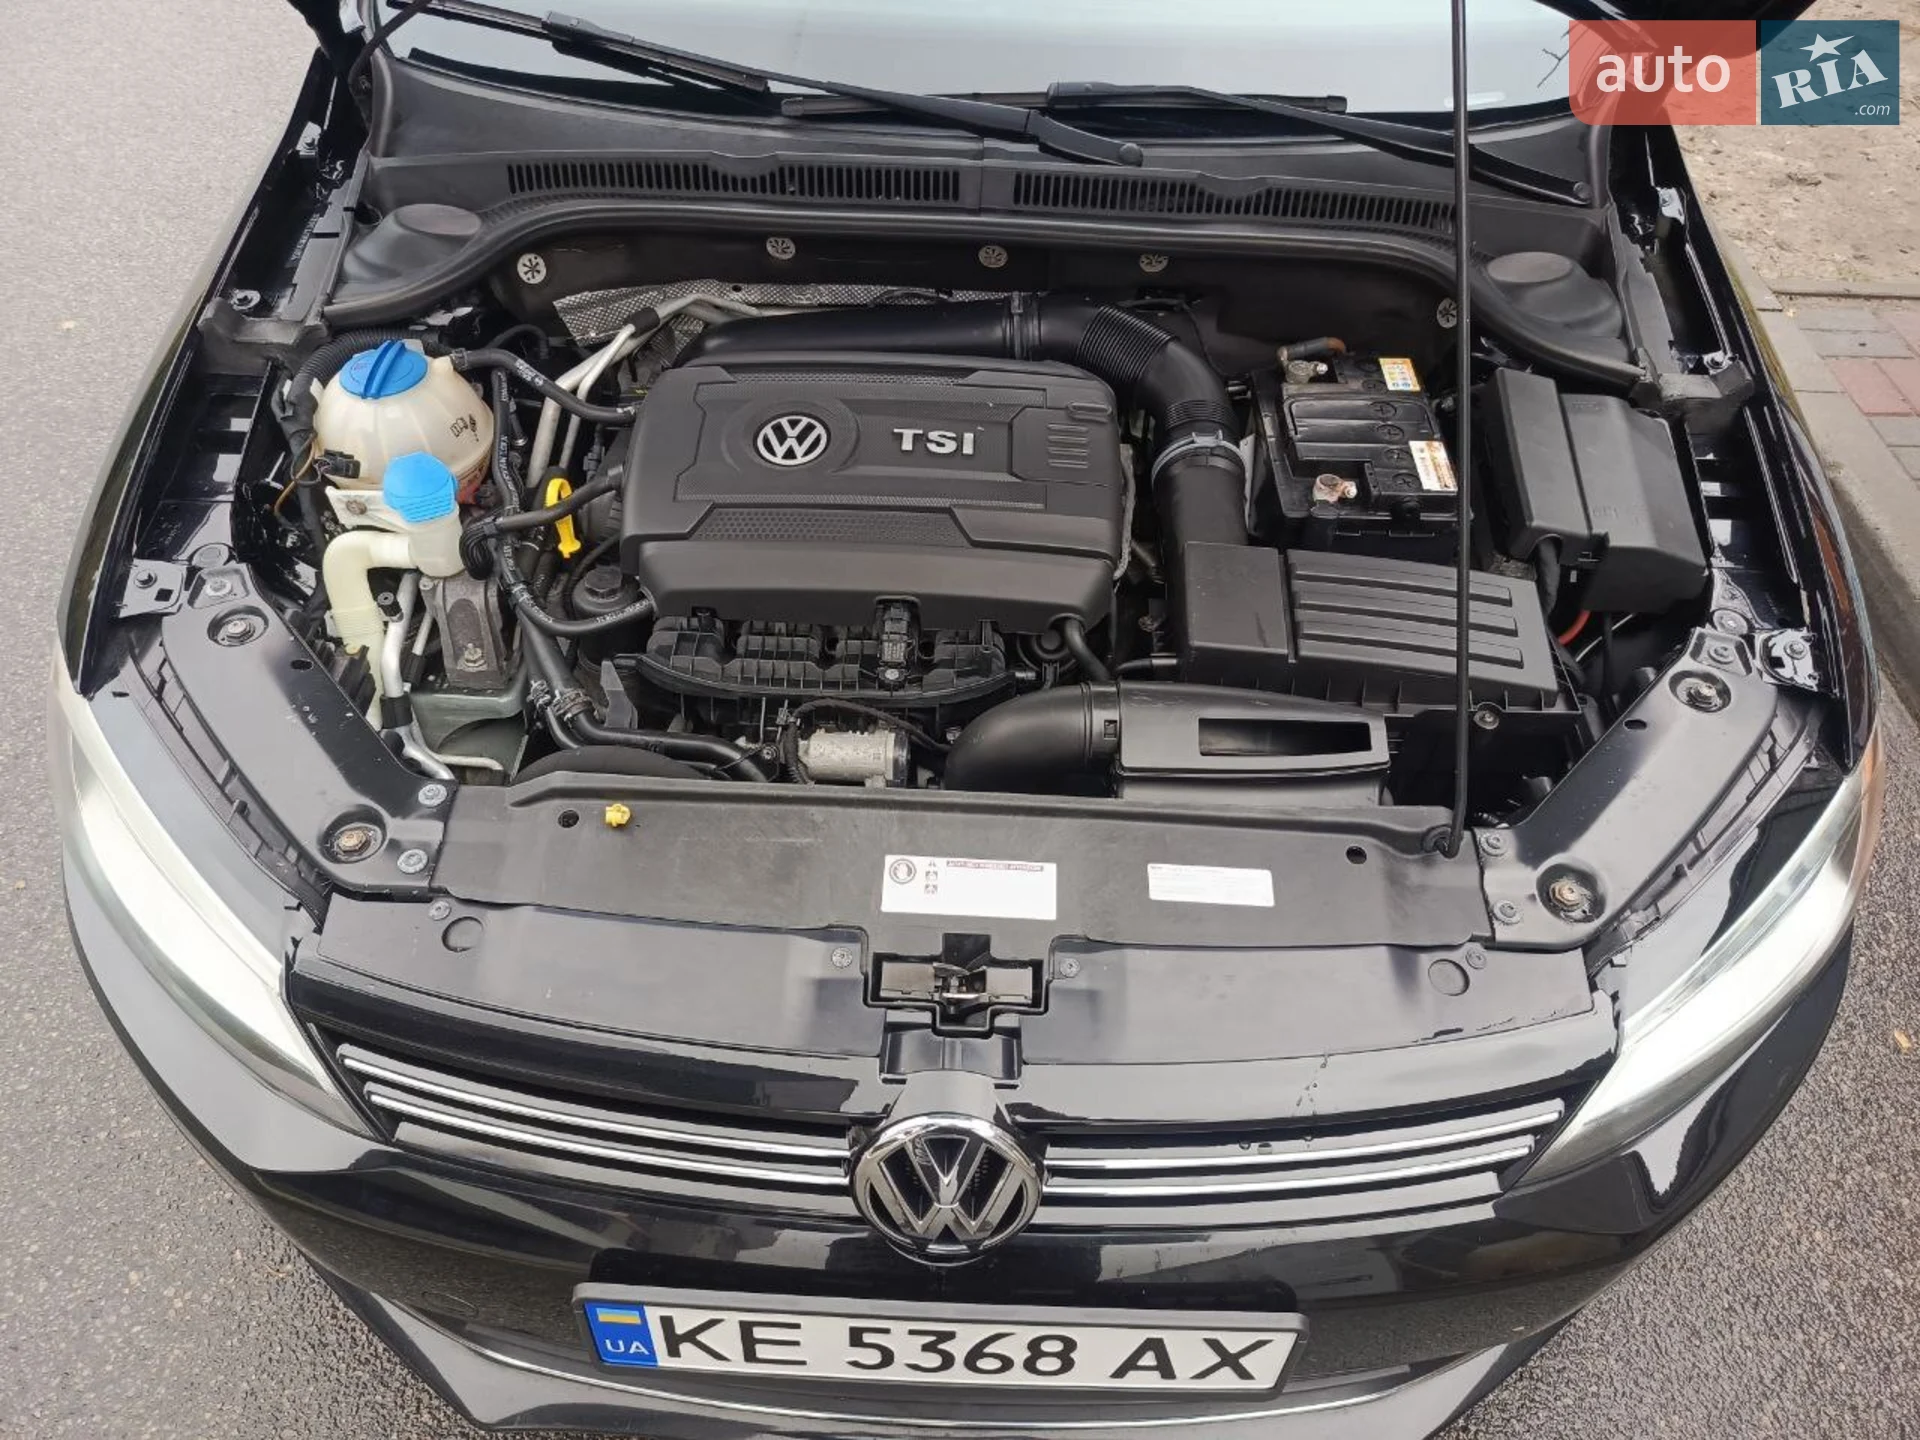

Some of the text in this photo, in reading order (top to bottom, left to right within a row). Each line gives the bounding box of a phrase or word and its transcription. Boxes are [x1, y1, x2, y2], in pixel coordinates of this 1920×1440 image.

[893, 428, 975, 455] TSI
[605, 1339, 650, 1356] UA
[658, 1314, 1275, 1381] KE 5368 AX
